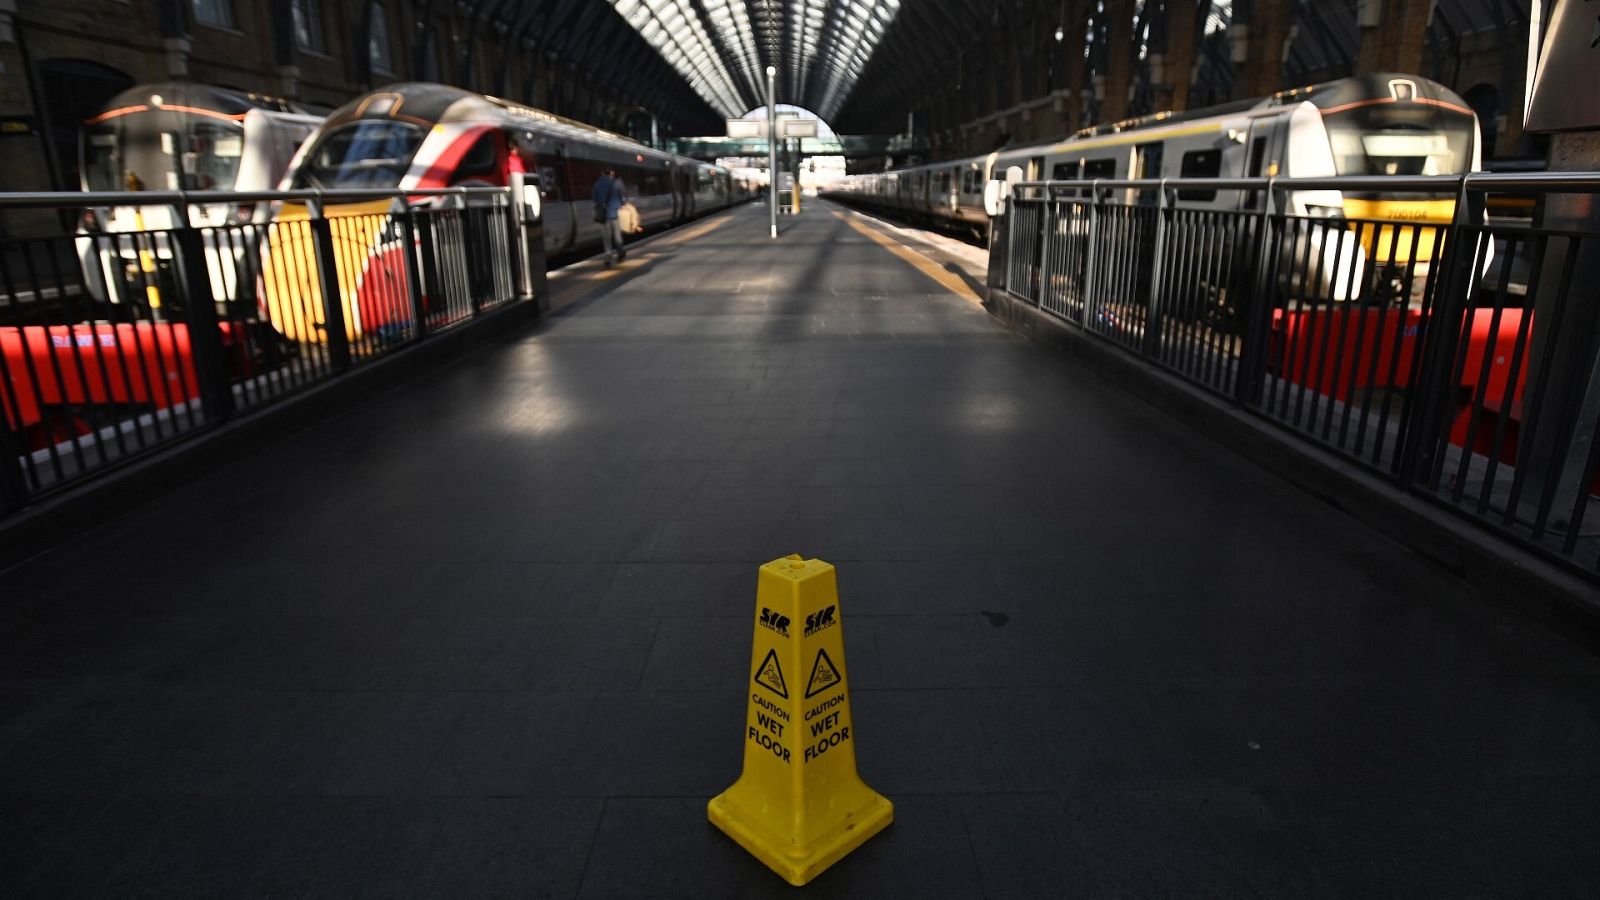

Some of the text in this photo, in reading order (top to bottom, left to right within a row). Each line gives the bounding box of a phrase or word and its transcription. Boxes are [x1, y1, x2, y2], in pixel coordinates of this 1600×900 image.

[752, 695, 790, 722] CAUTION
[804, 694, 844, 721] CAUTION
[757, 711, 784, 738] WET
[811, 711, 840, 737] WET
[749, 727, 791, 764] FLOOR
[804, 727, 850, 763] FLOOR
